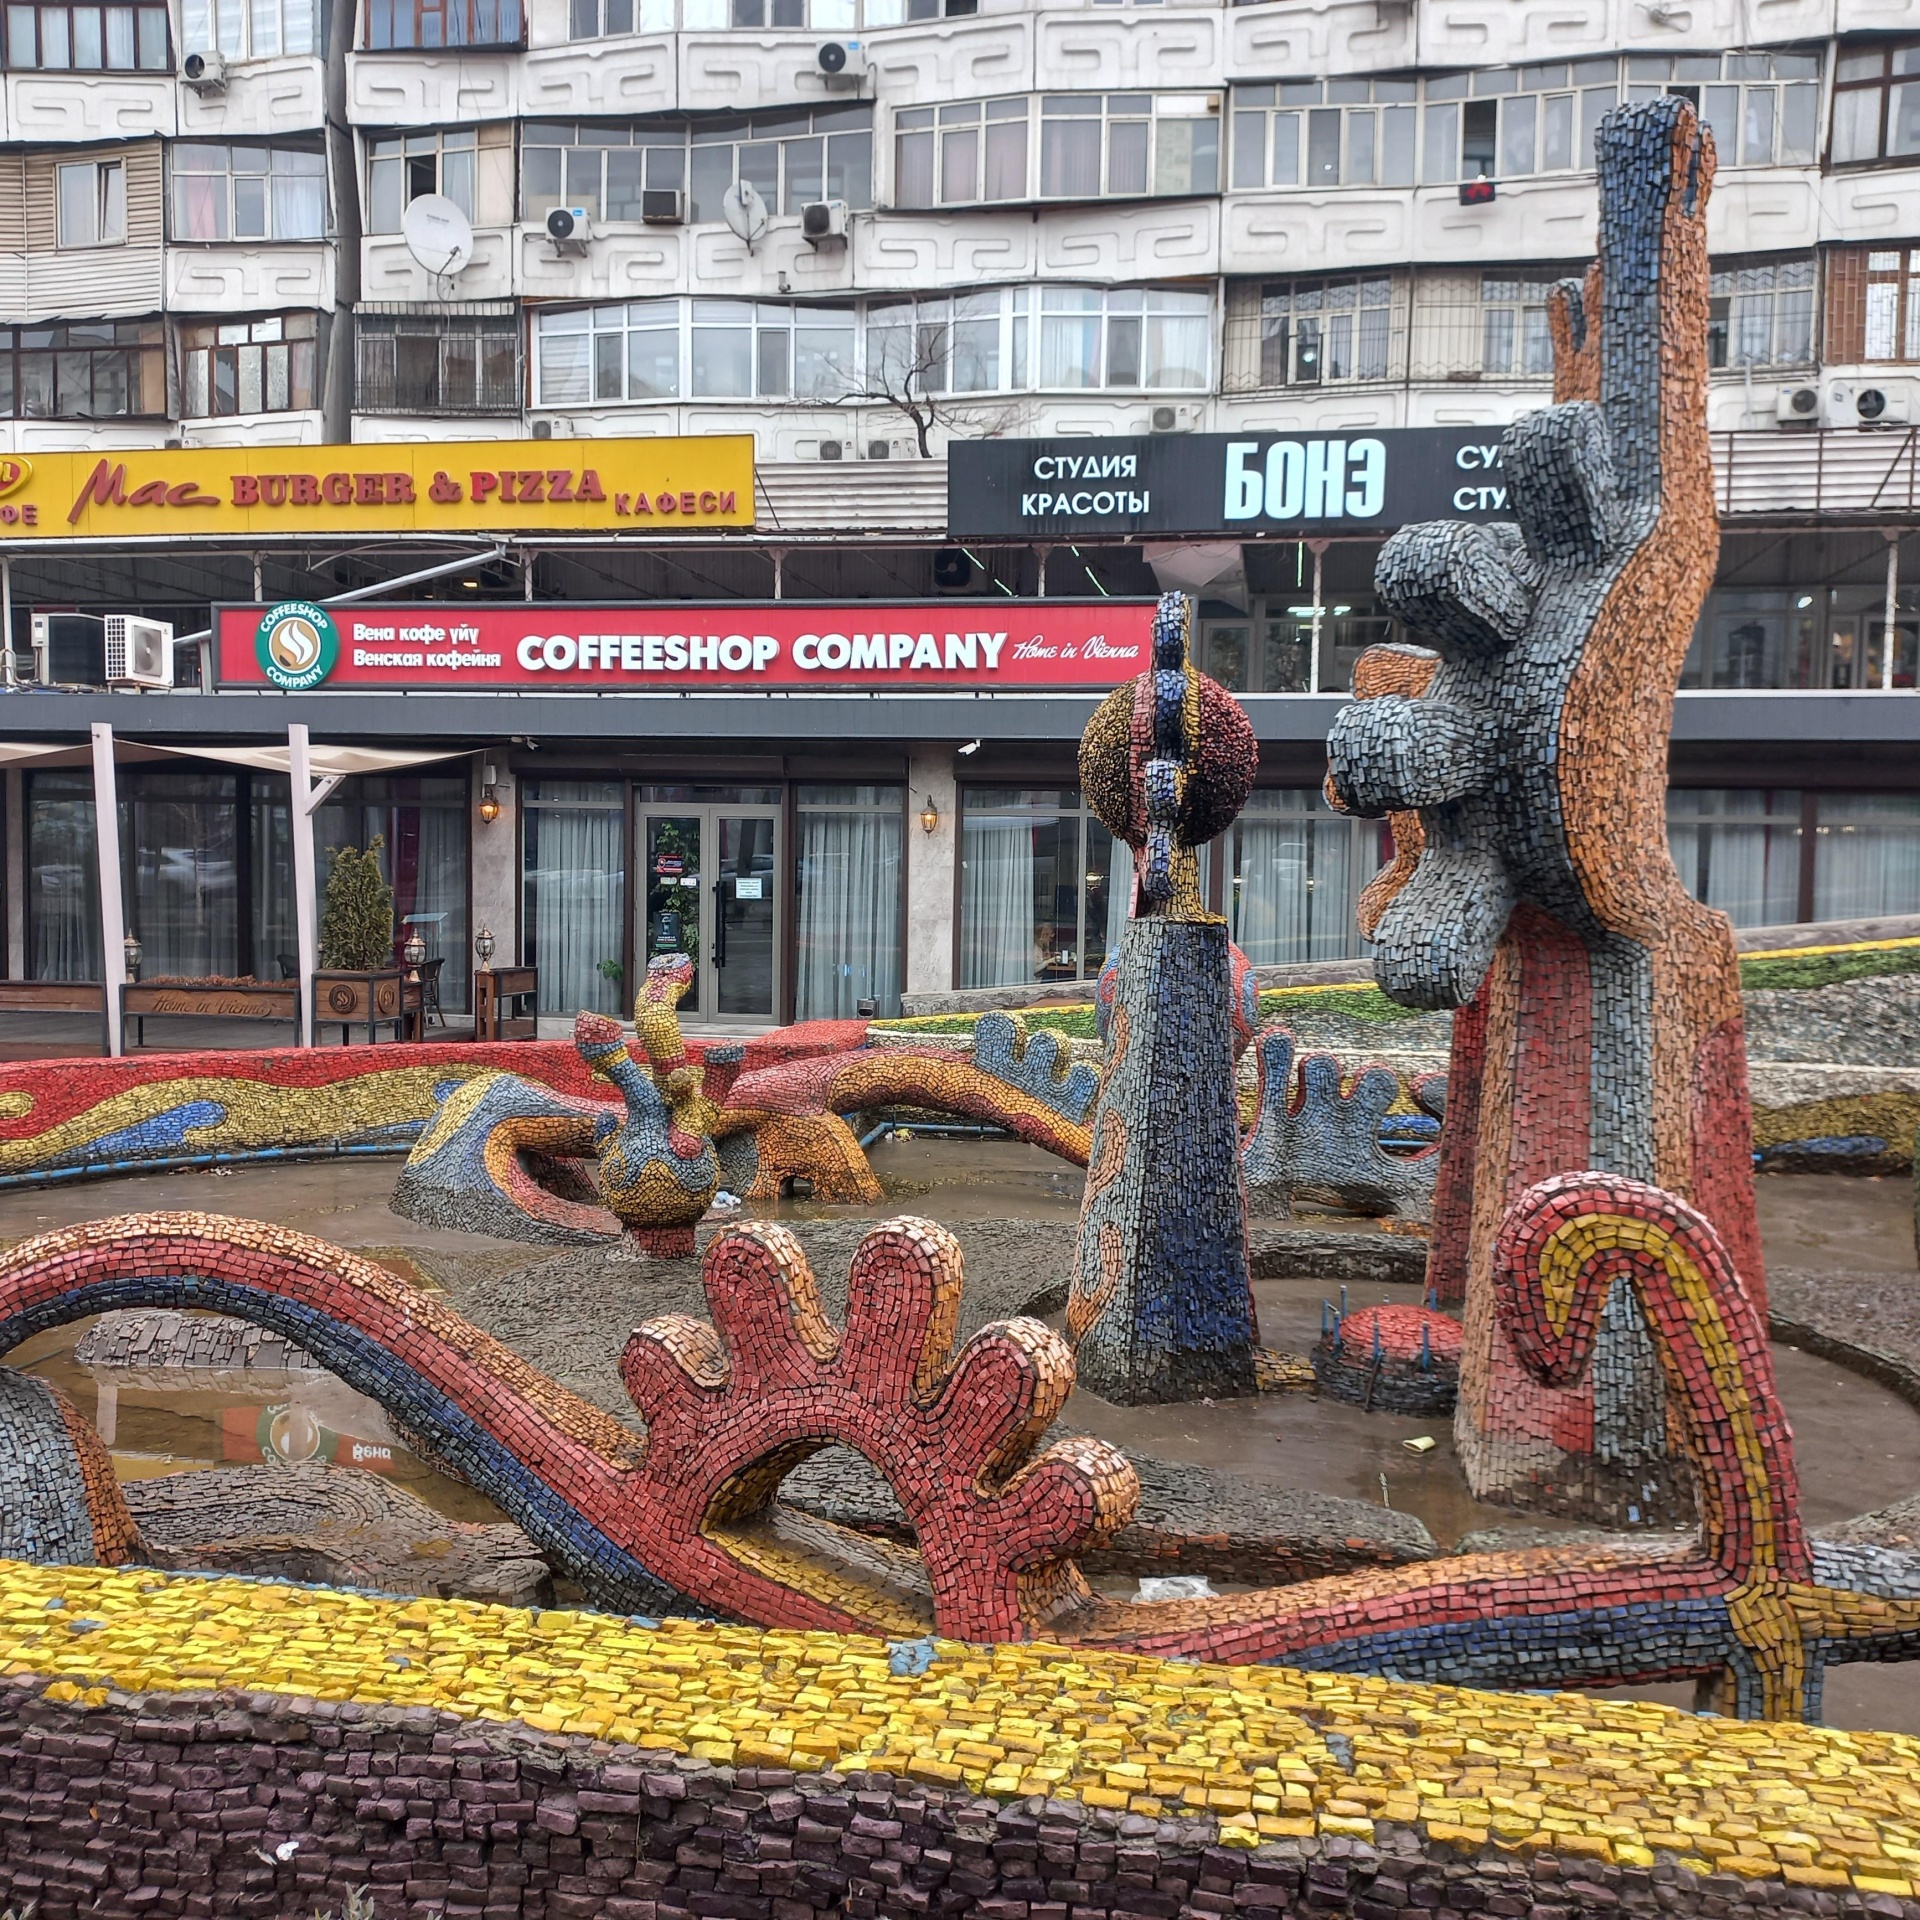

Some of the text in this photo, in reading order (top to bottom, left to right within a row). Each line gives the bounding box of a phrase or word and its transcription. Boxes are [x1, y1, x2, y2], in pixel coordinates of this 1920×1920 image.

[1034, 454, 1137, 479] СТУДИЯ
[1456, 444, 1503, 469] СУ
[66, 458, 607, 524] Mac BURGER & PIZZA
[1223, 437, 1387, 520] БОНЭ
[614, 490, 737, 516] КАФЕСИ
[1022, 490, 1150, 516] КРАСОТЫ
[1453, 486, 1512, 511] СТУ
[260, 603, 328, 632] COFFEESHOP
[353, 623, 395, 641] Вена
[399, 624, 446, 645] кофе
[353, 649, 501, 670] Венская кофейня
[516, 632, 1009, 671] COFFEESHOP COMPANY
[1012, 634, 1139, 660] Home in Vienna
[266, 664, 323, 688] COMPANY
[152, 989, 192, 1013] Home
